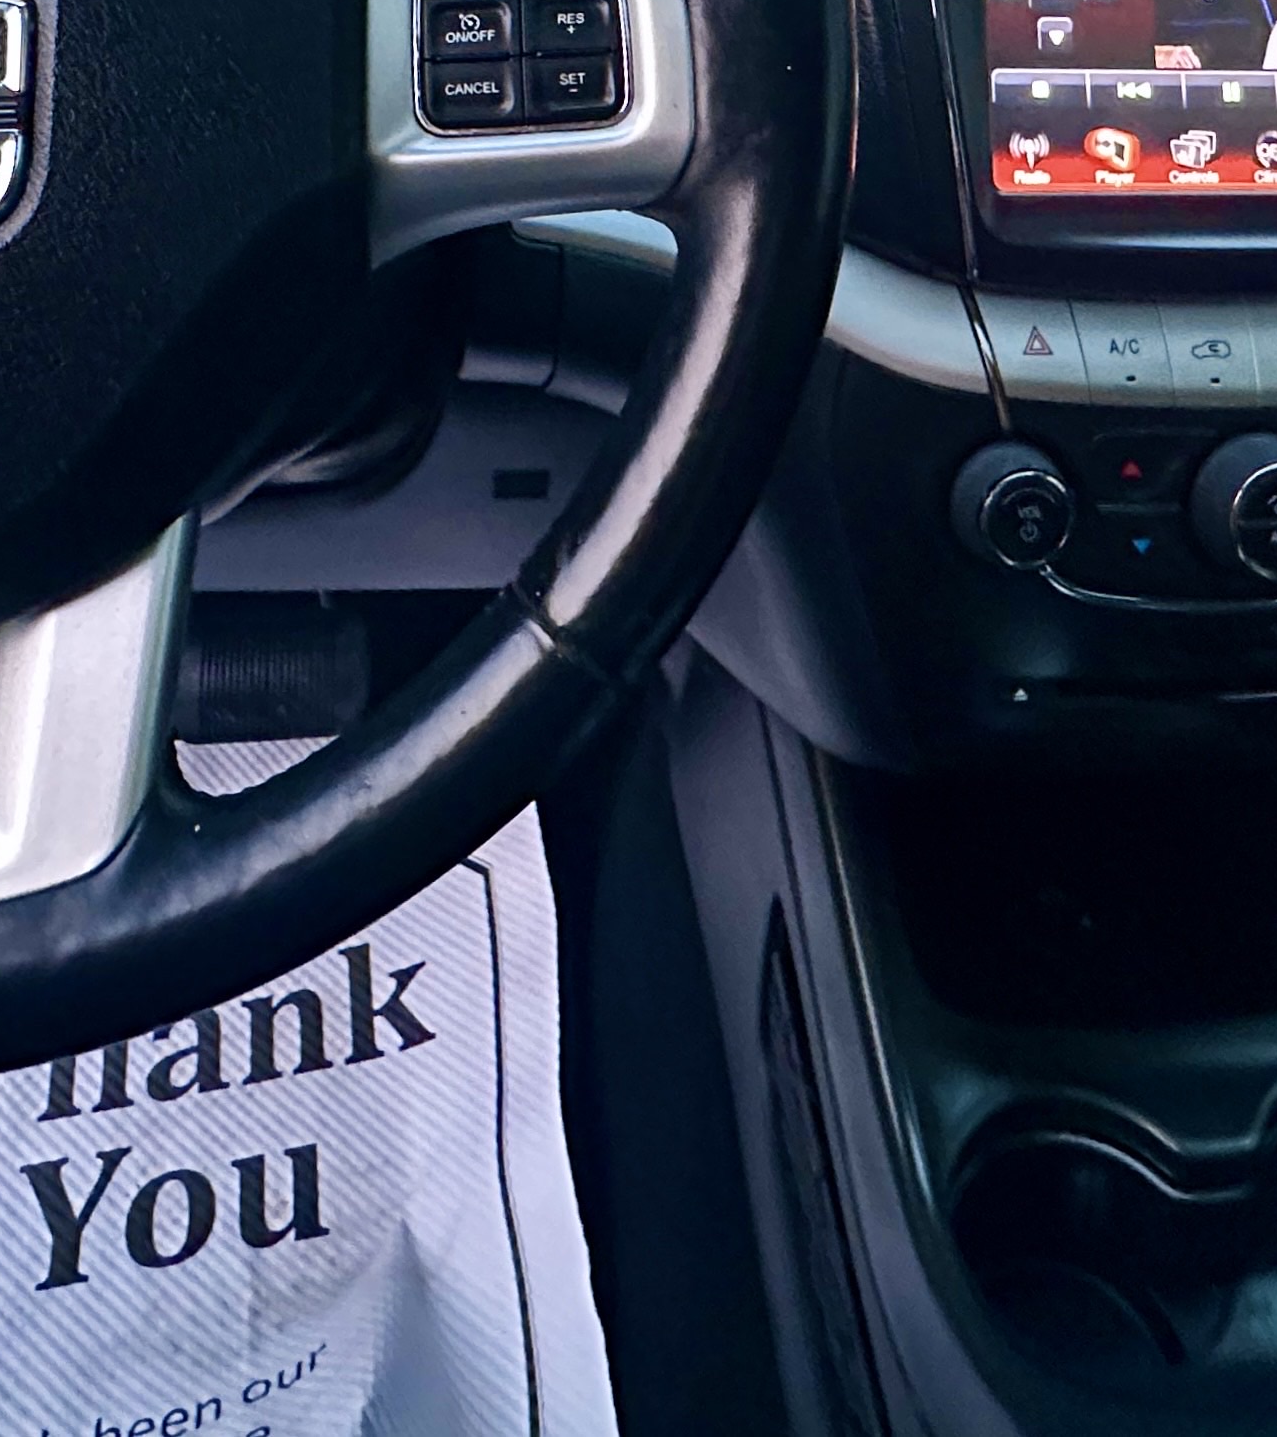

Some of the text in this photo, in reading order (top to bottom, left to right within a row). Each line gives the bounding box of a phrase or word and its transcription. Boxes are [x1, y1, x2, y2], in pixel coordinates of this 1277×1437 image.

[557, 13, 585, 25] RES
[445, 29, 496, 44] ON/OFF
[559, 72, 586, 85] SET
[445, 81, 500, 96] CANCEL
[1013, 170, 1051, 185] Radio
[1095, 170, 1135, 187] Player
[1169, 170, 1219, 184] Controls
[1109, 338, 1140, 356] A/C
[20, 1144, 330, 1293] You
[241, 1343, 327, 1403] our
